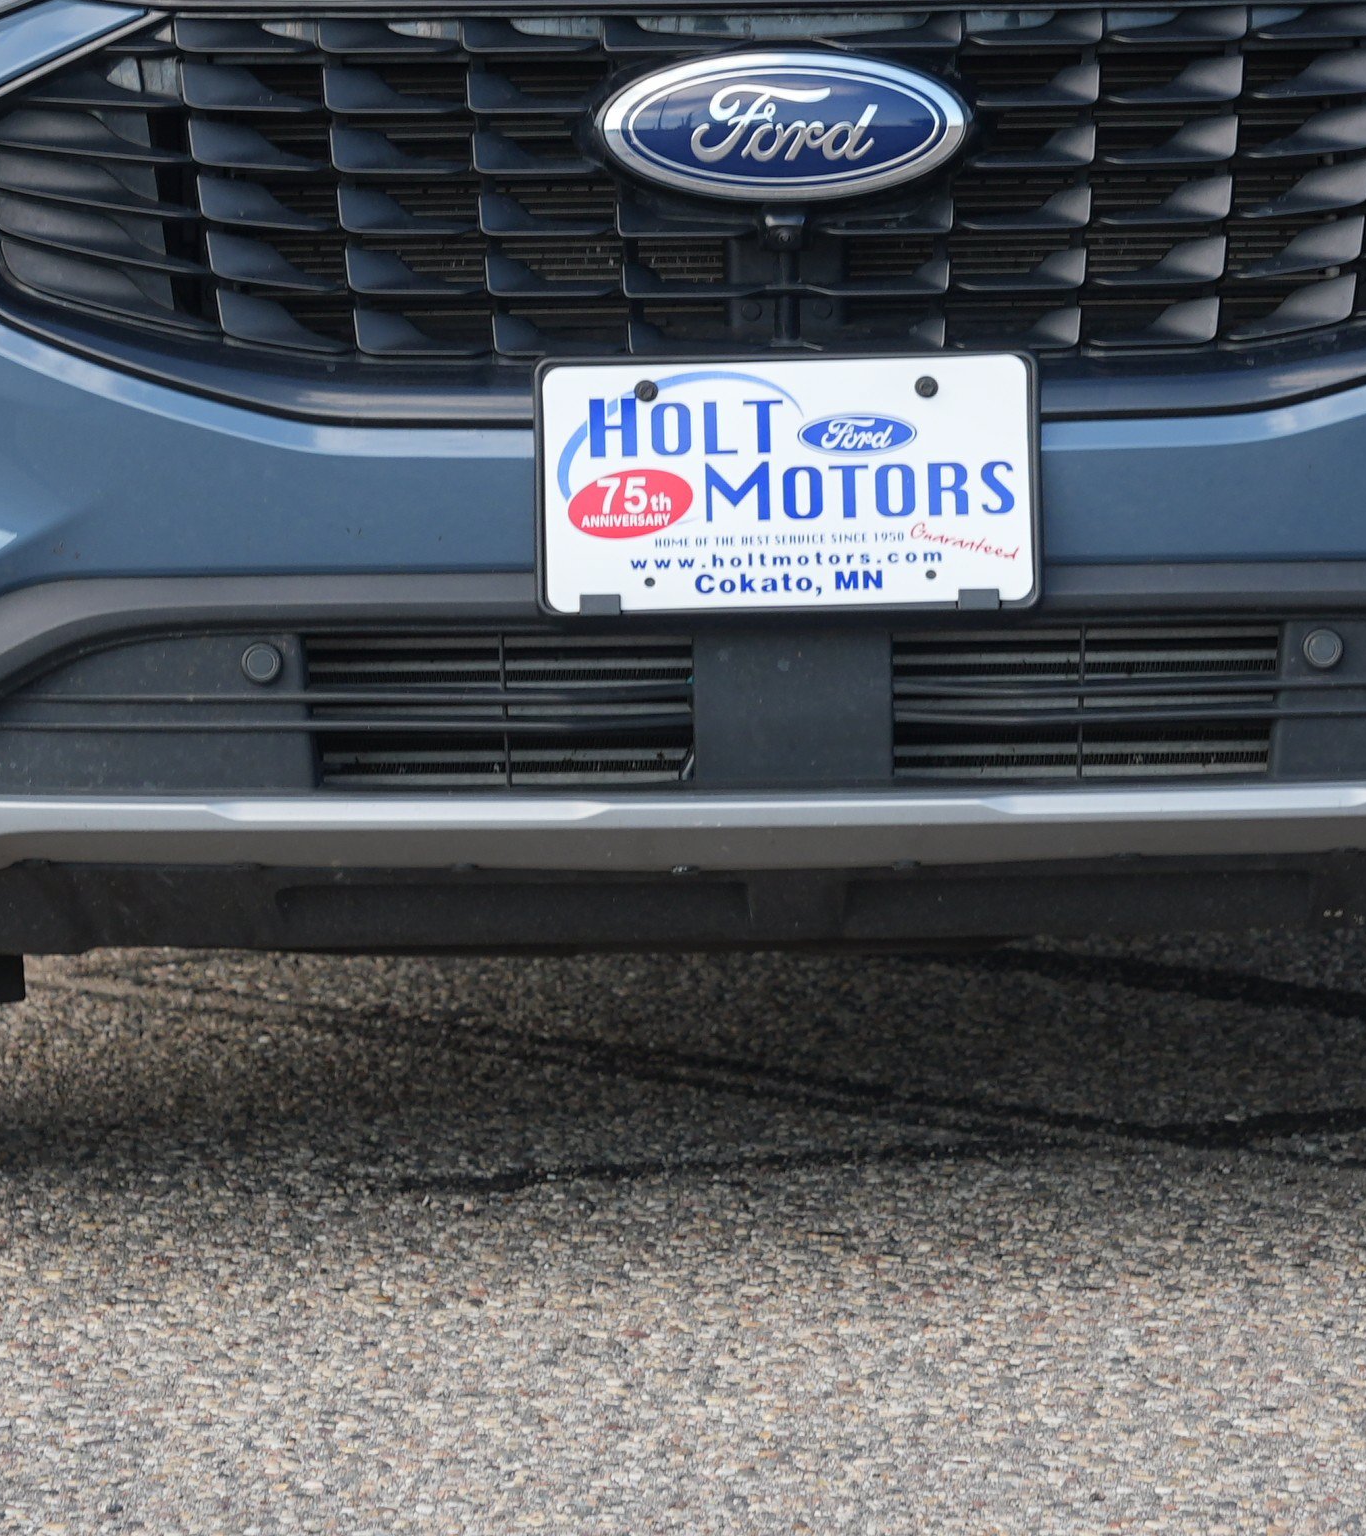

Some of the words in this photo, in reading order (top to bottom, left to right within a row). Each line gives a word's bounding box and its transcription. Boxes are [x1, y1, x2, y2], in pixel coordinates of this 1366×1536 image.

[690, 84, 878, 163] Ford
[589, 398, 784, 458] HOLT
[820, 418, 894, 450] Ford
[596, 476, 672, 515] 75th
[704, 461, 1016, 523] MOTORS
[581, 512, 671, 529] ANNIVERSARY
[654, 537, 690, 549] HOME
[695, 536, 708, 547] OF
[715, 536, 736, 547] THE
[741, 534, 770, 545] BEST
[776, 532, 827, 544] SERVICE
[831, 531, 868, 544] SINCE
[873, 531, 905, 543] 1950
[910, 521, 1020, 561] Guaranteed
[630, 550, 944, 571] www.holtmotors.com
[694, 572, 823, 596] Cokato,
[834, 570, 884, 590] MN
